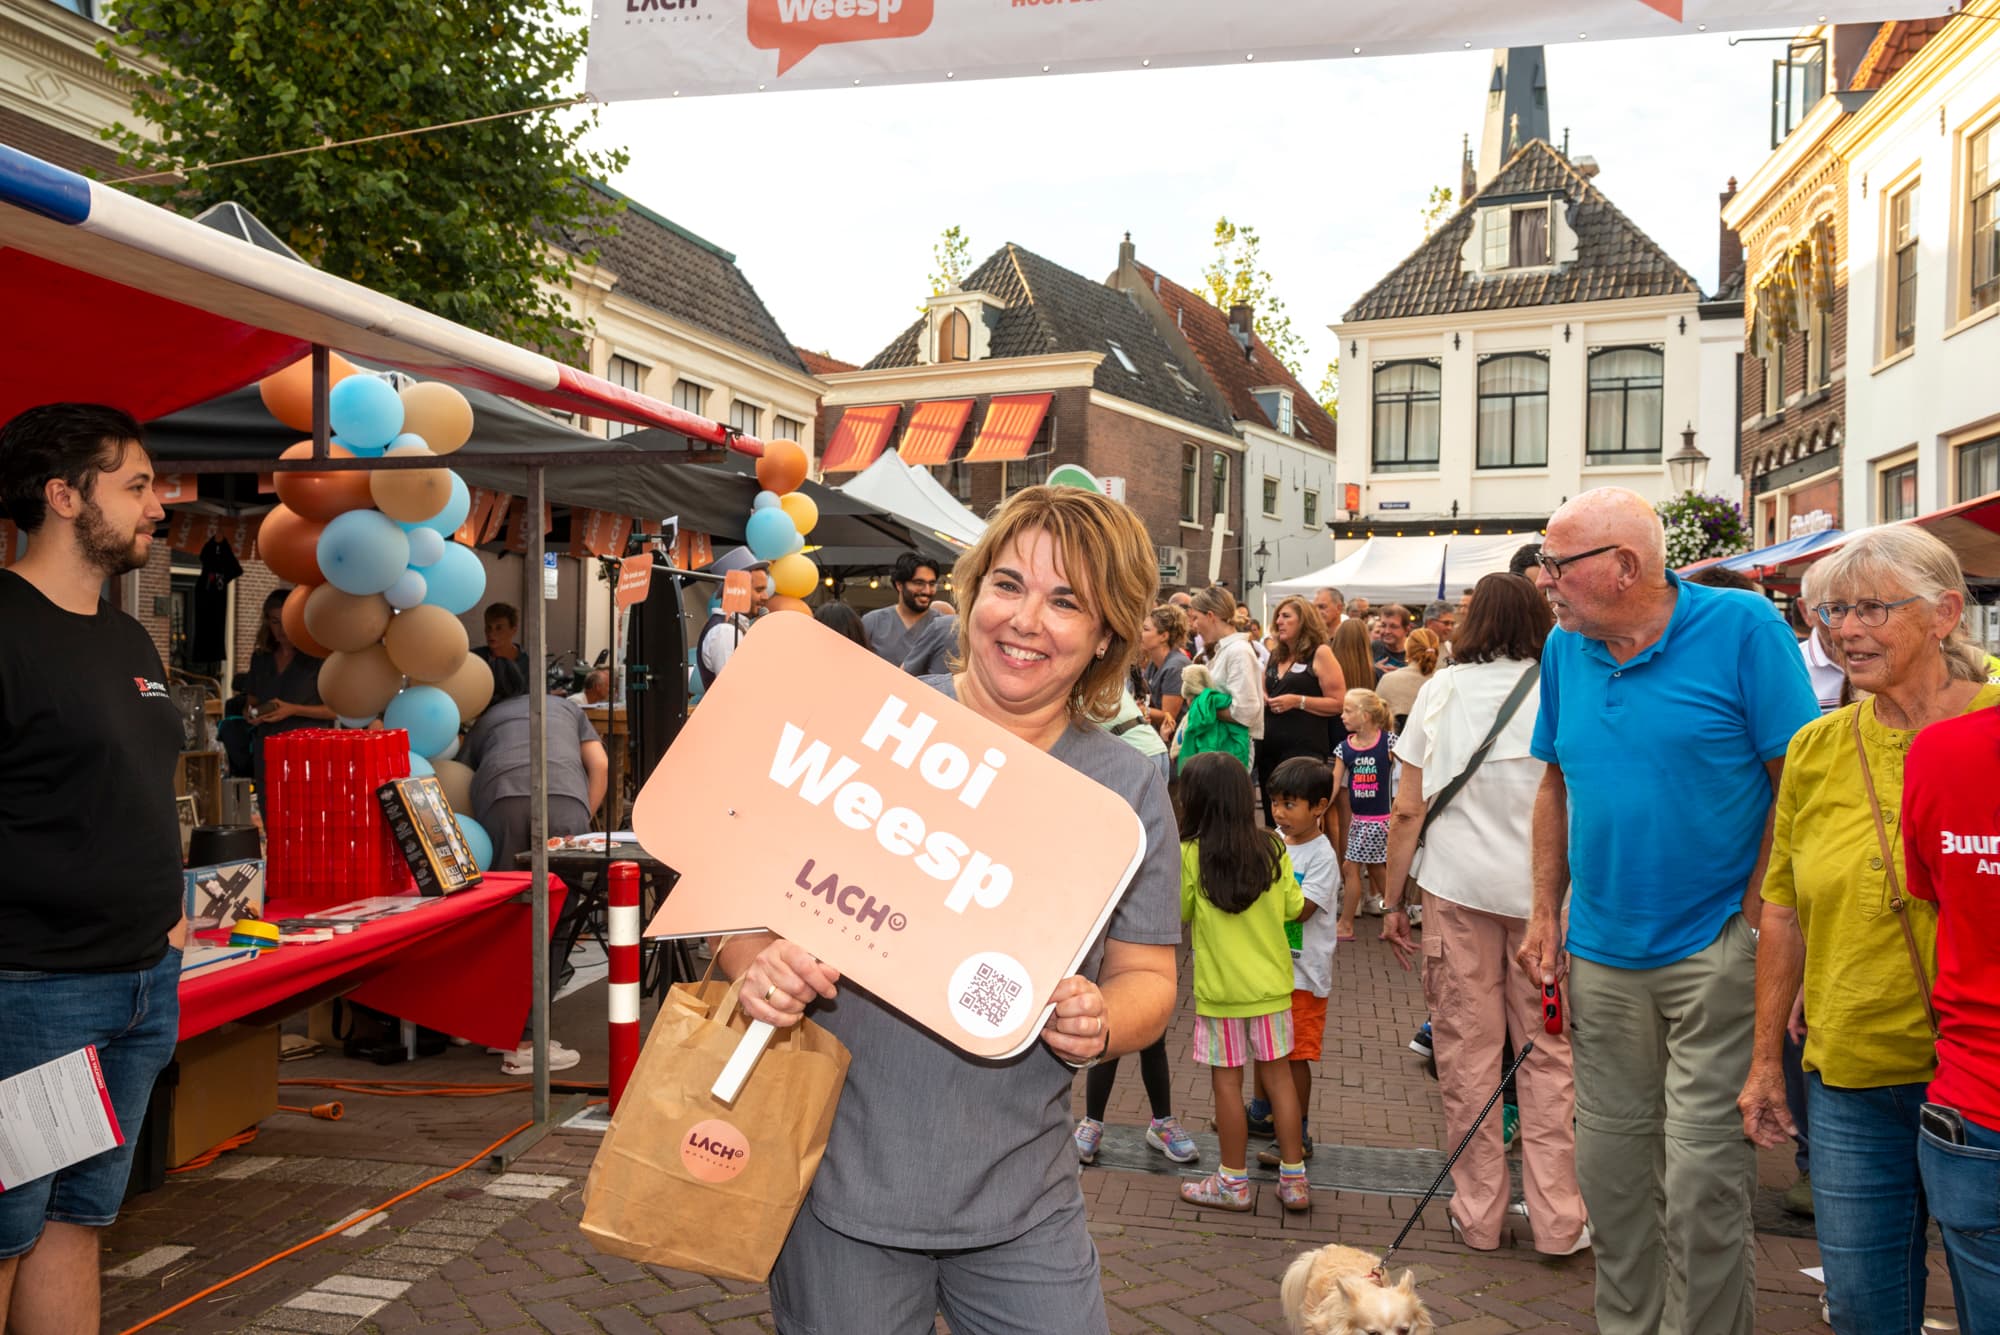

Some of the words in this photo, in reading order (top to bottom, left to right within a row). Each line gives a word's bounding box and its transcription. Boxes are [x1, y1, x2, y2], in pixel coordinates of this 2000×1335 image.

[776, 0, 901, 24] Weesp
[860, 694, 1007, 809] Hoi
[1355, 757, 1376, 766] CIAO
[768, 721, 1014, 914] Weesp
[785, 891, 889, 959] MONDZORG
[795, 858, 891, 932] LACH
[688, 1132, 735, 1161] LACH
